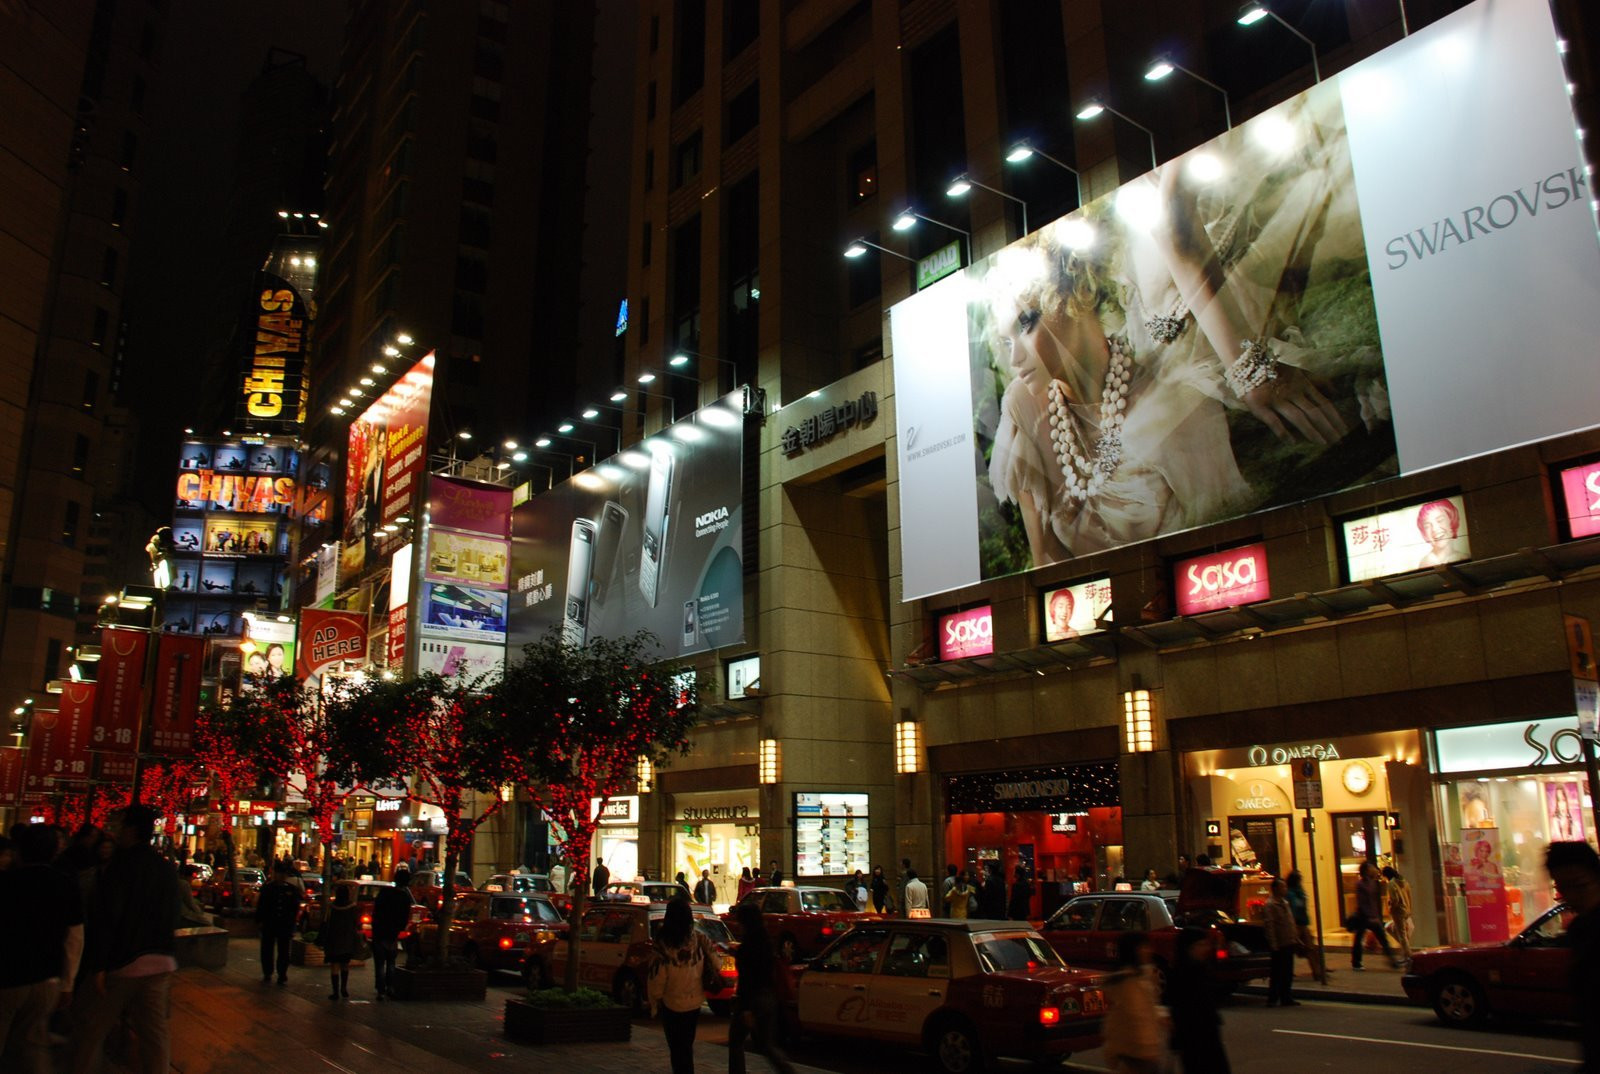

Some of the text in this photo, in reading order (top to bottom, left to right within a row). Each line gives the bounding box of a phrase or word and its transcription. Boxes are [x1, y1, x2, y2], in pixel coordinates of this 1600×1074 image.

[247, 289, 294, 417] CHIVAS
[781, 391, 878, 456] 金朝陽中心
[177, 472, 295, 505] CHIVAS
[695, 507, 729, 528] NOKIA
[313, 626, 337, 645] AD
[424, 624, 449, 632] SAMSUNG
[312, 637, 361, 662] HERE
[1271, 744, 1340, 765] OMEGA
[994, 779, 1069, 800] SWAROVSKI
[683, 804, 748, 820] shu uemura
[1235, 798, 1282, 811] OMEGA
